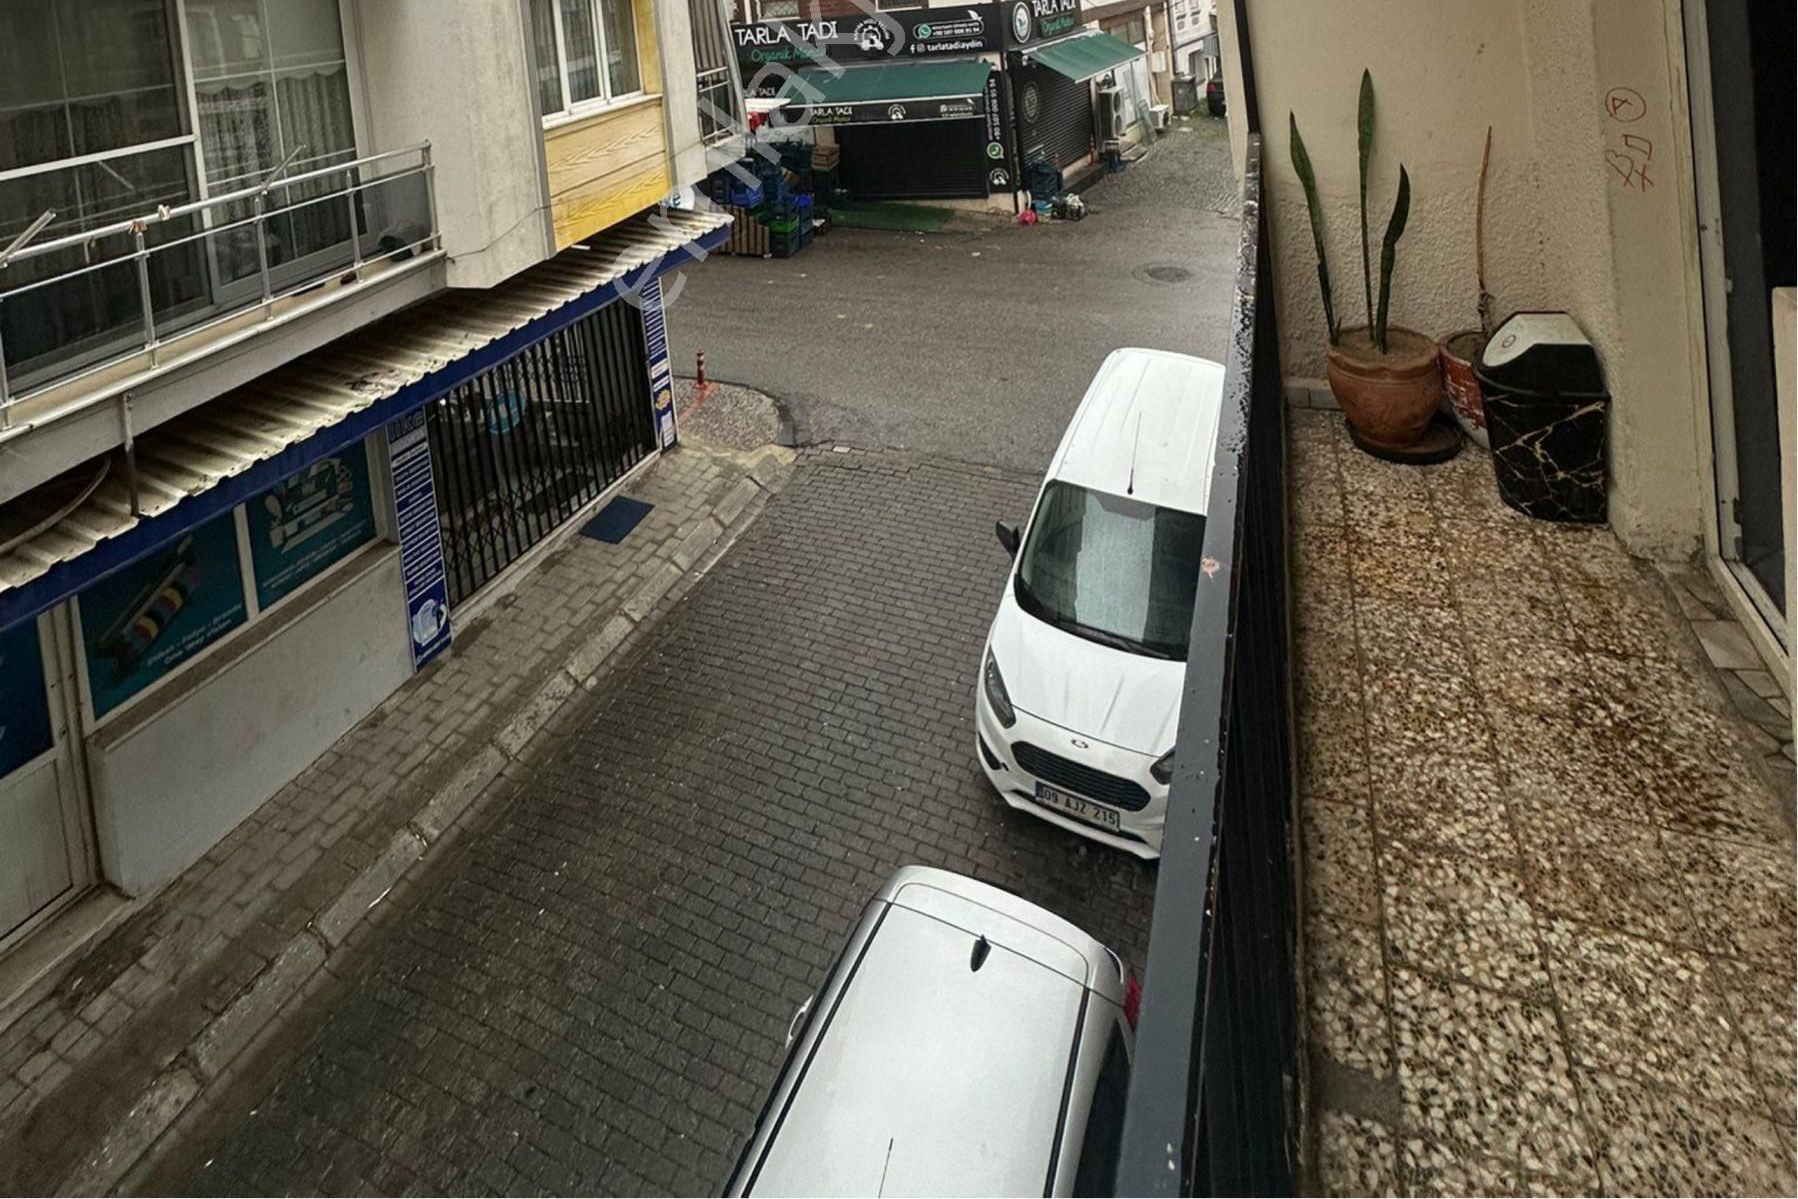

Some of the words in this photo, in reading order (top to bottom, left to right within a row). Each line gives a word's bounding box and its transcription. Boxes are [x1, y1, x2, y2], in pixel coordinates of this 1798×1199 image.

[735, 25, 791, 46] TARLA
[797, 21, 839, 41] TADI
[926, 40, 983, 52] tarlatadiaydin
[1044, 789, 1059, 804] 09
[1065, 797, 1087, 815] AJZ
[1093, 806, 1116, 825] 215
